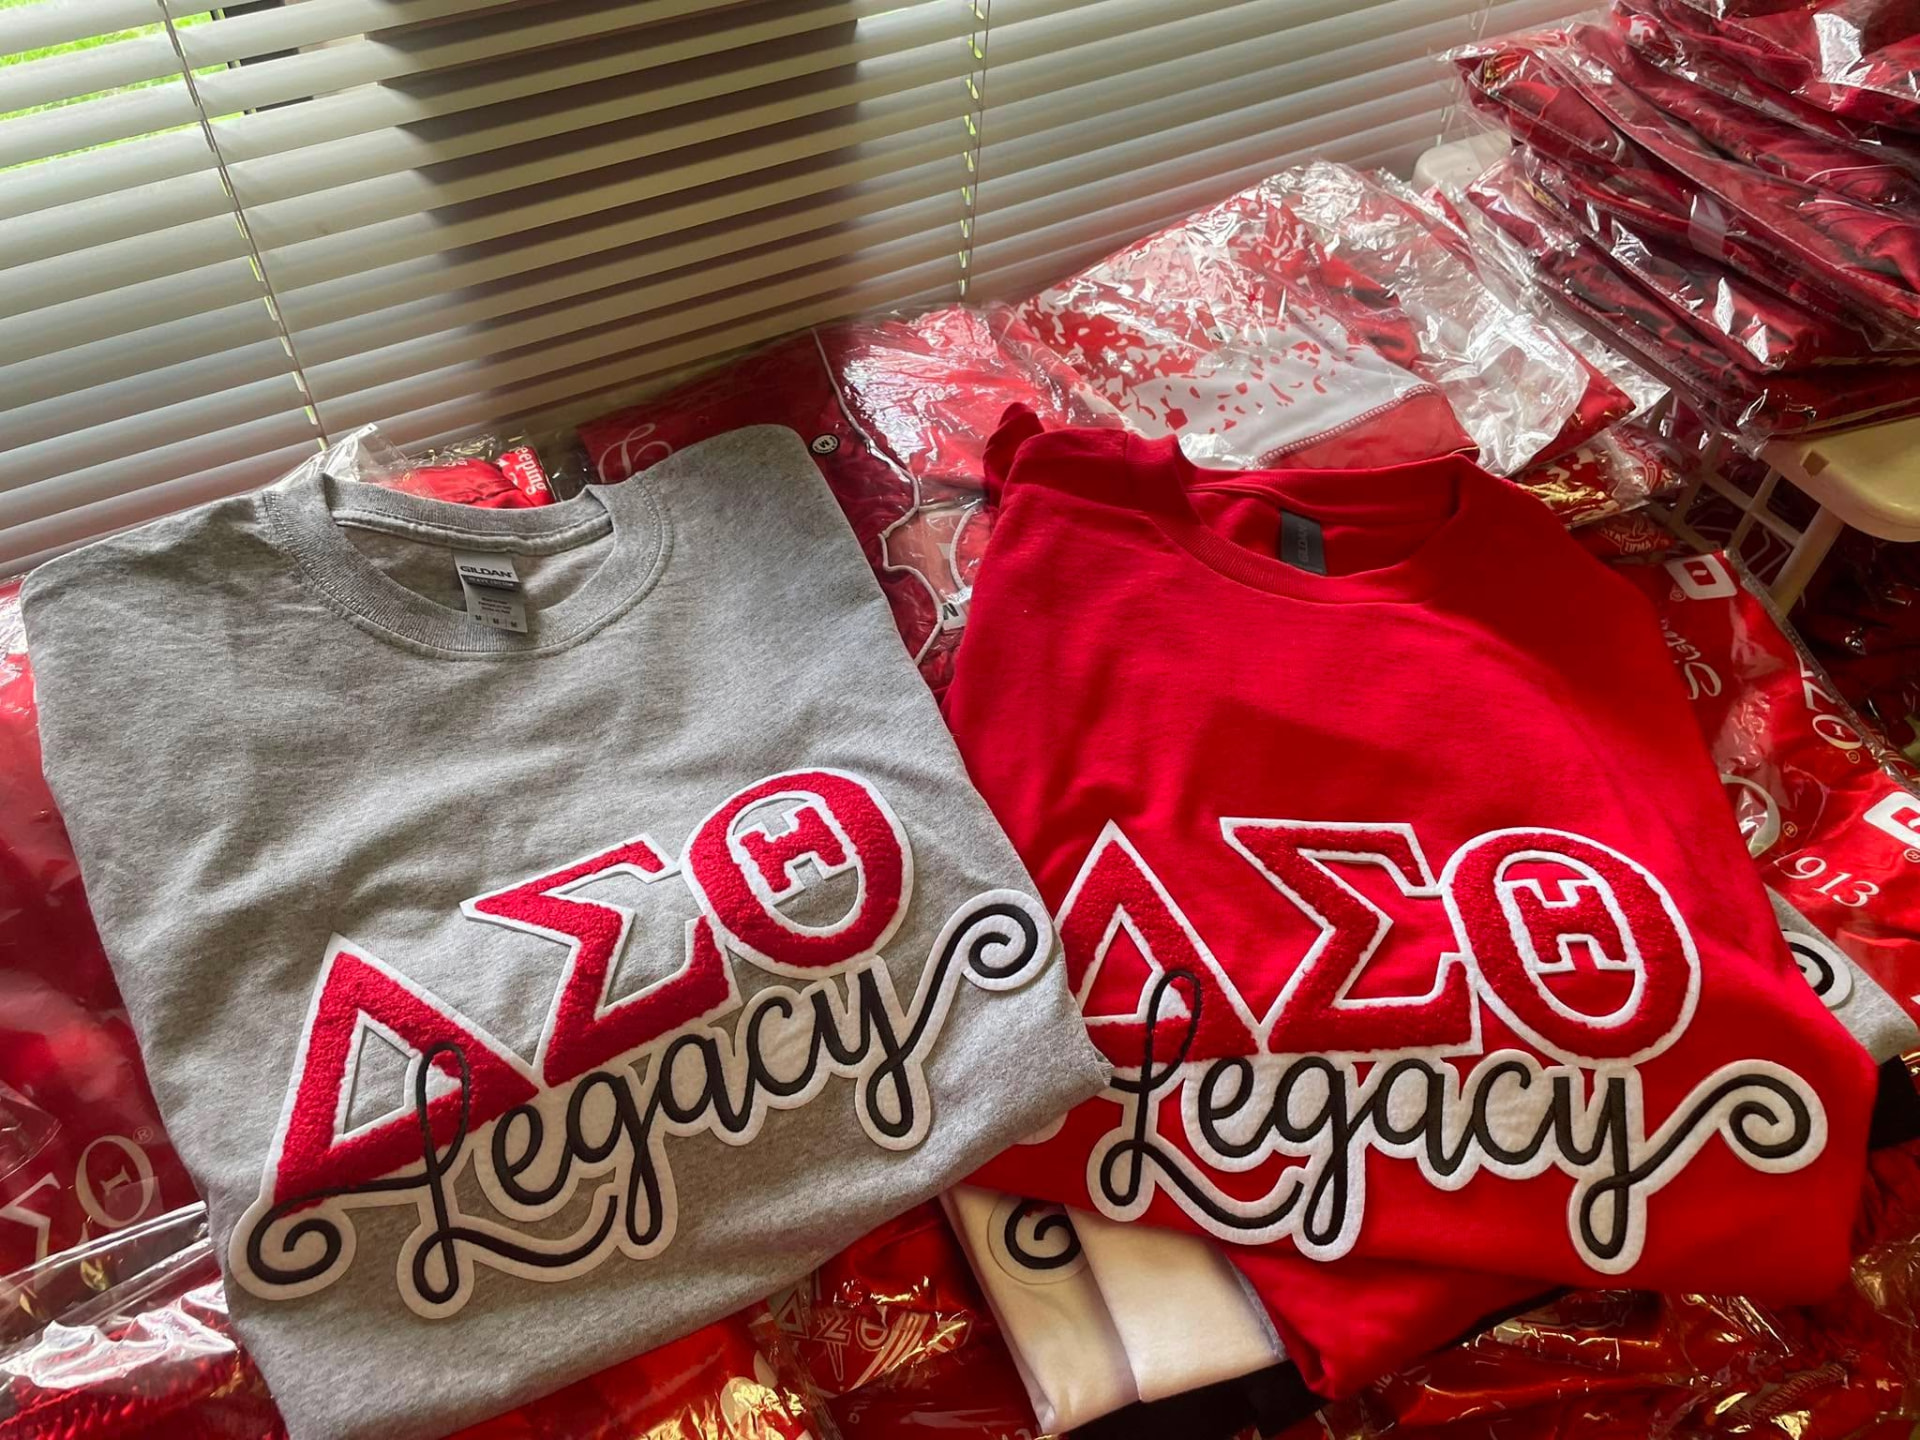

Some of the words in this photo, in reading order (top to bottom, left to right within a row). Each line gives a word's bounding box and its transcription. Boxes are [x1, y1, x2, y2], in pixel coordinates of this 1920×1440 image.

[460, 565, 512, 578] GILDAN
[242, 900, 1044, 1308] Legacy
[1100, 970, 1815, 1262] Legacy
